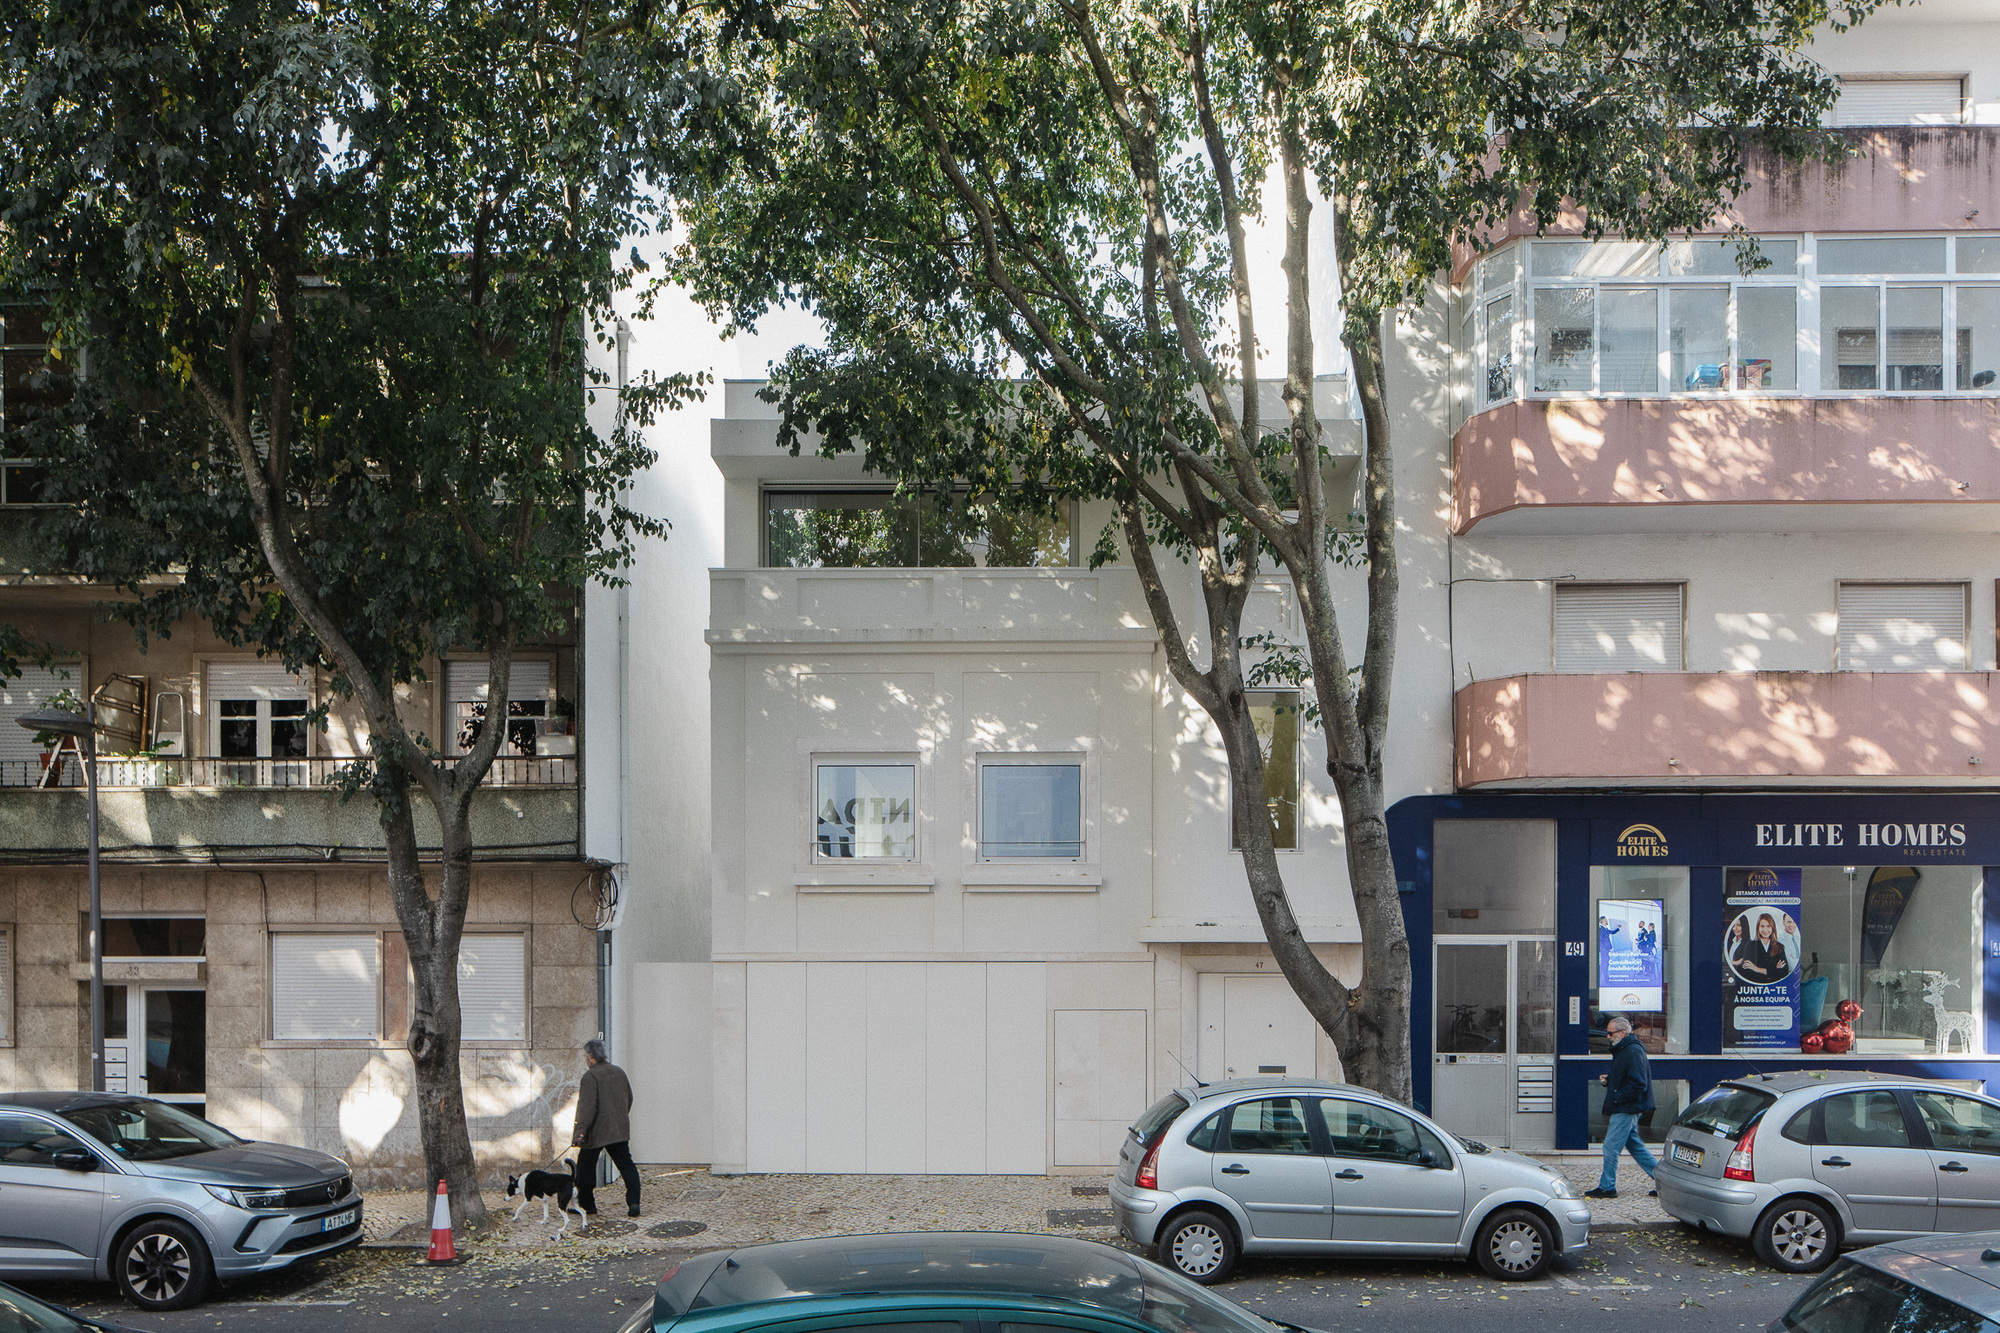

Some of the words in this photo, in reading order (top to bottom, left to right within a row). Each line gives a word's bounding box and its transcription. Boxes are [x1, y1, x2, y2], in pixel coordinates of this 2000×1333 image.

[1755, 823, 1844, 847] ELITE
[1857, 823, 1967, 847] HOMES
[1627, 836, 1658, 846] ELITE
[1616, 845, 1669, 857] HOMES
[1567, 942, 1582, 956] 49
[1255, 961, 1264, 969] 47
[1737, 986, 1787, 995] JUNTA-TE
[1734, 995, 1739, 1003] À
